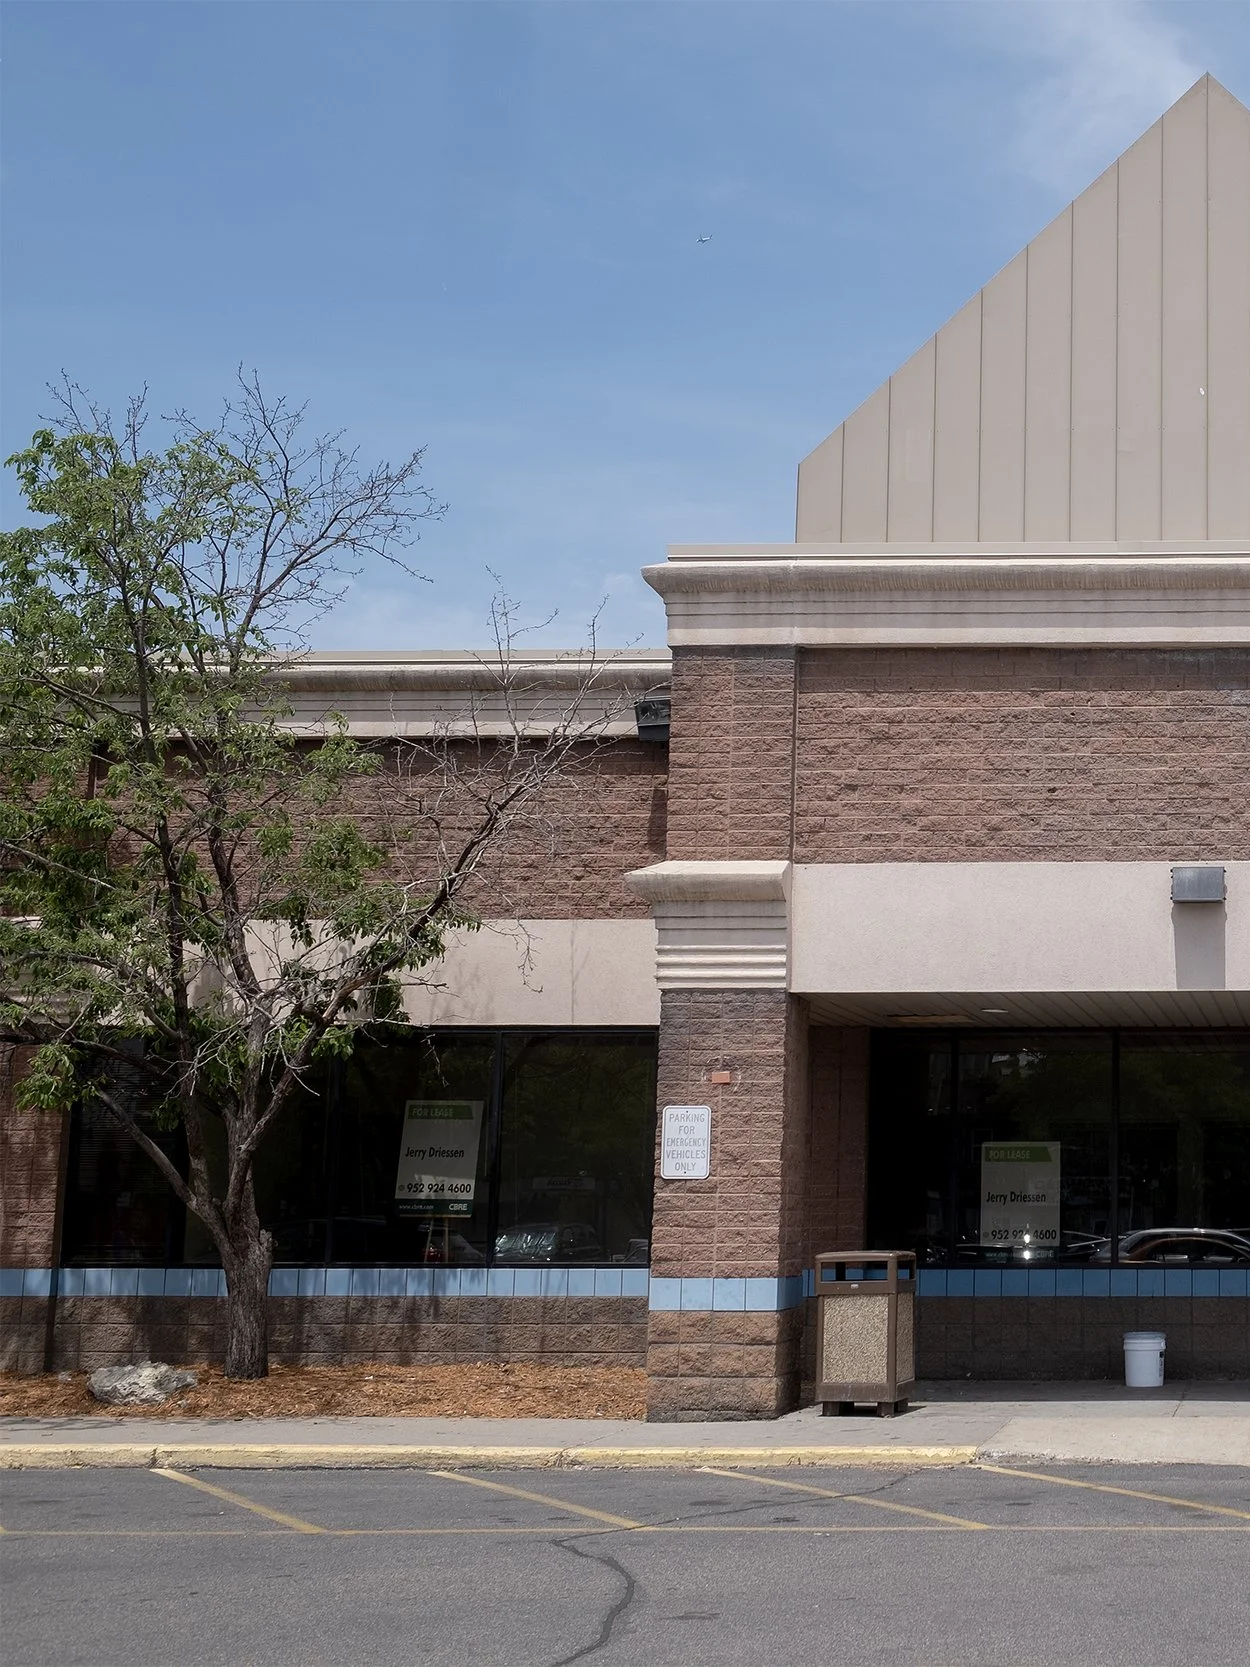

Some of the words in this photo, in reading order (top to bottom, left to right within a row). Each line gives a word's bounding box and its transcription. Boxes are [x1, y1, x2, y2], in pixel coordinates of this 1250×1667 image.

[411, 1108, 428, 1117] FOR
[430, 1108, 453, 1117] LEASE
[669, 1113, 705, 1122] PARKING
[678, 1125, 696, 1134] FOR
[666, 1137, 706, 1147] EMERGENCY
[405, 1146, 427, 1160] Jerry
[429, 1146, 465, 1158] Driessen
[666, 1149, 706, 1159] VEHICLES
[989, 1150, 1005, 1159] FOR
[1007, 1150, 1031, 1159] LEASE
[674, 1162, 696, 1171] ONLY
[406, 1183, 425, 1193] 952
[427, 1183, 445, 1193] 924
[448, 1183, 472, 1193] 4600
[986, 1191, 1008, 1205] Jerry
[1010, 1191, 1046, 1202] Driessen
[448, 1203, 468, 1211] CBRE
[991, 1229, 1009, 1240] 952
[1033, 1229, 1057, 1240] 4600
